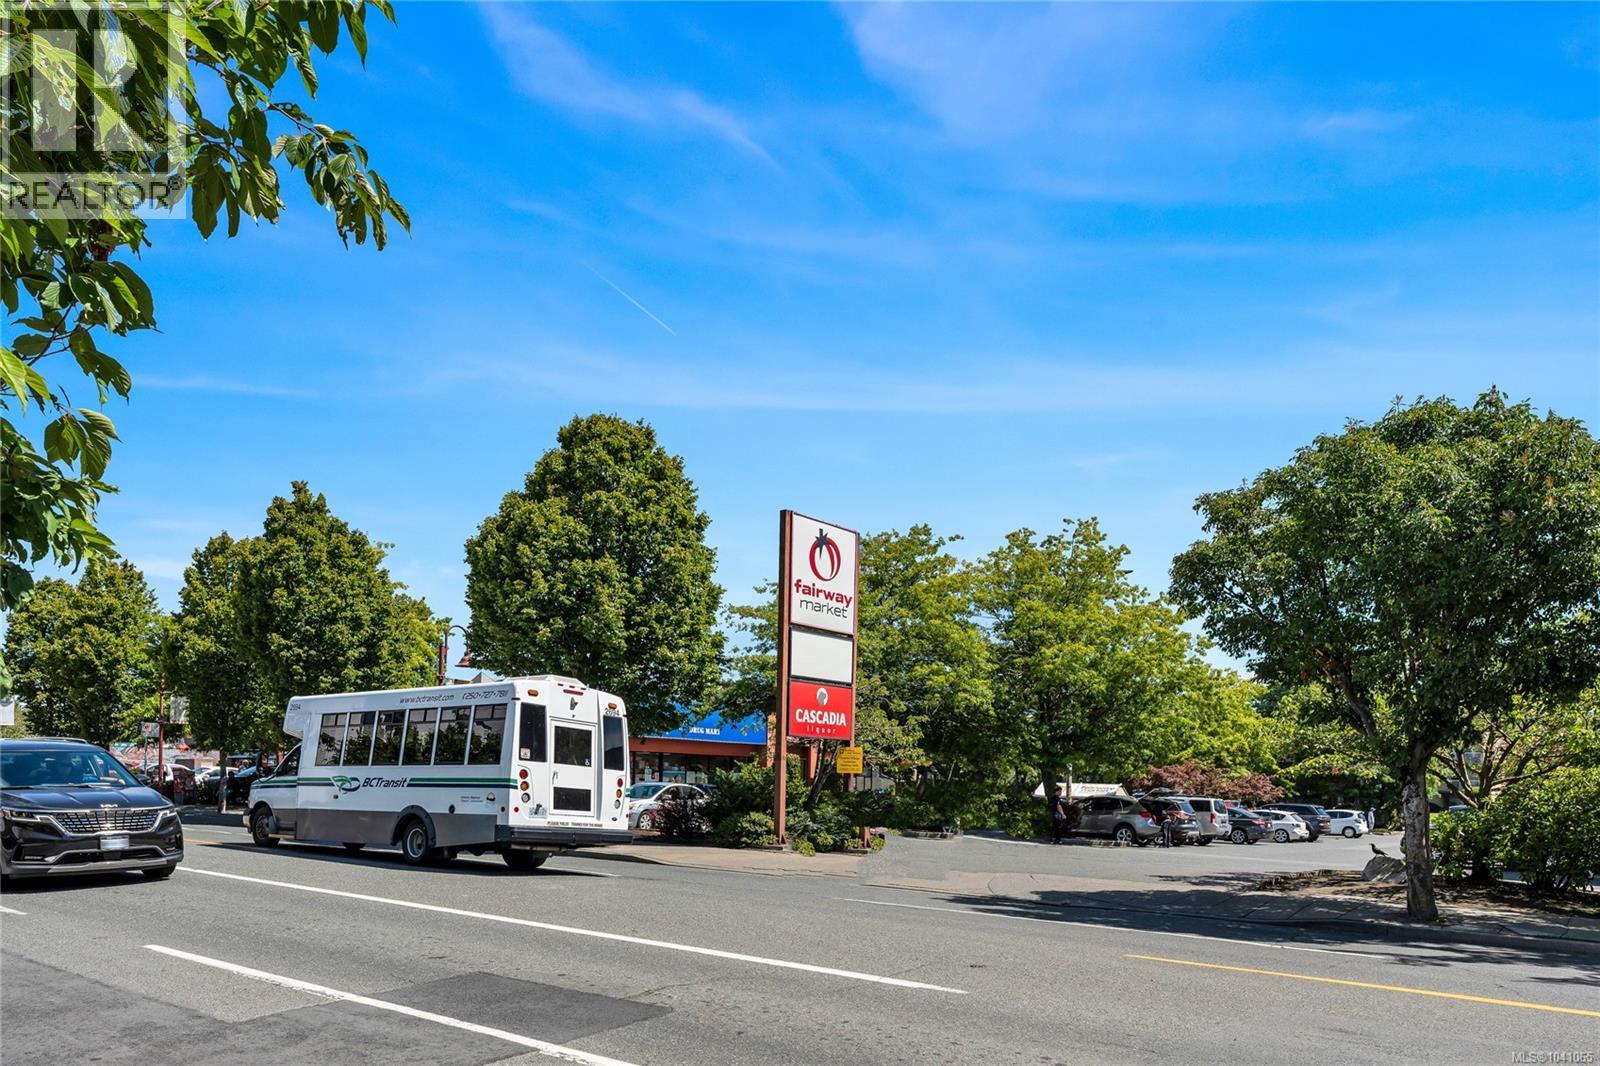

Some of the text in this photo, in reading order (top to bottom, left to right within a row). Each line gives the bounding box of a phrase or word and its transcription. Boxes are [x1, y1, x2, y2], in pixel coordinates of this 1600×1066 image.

[794, 579, 852, 608] fairway
[800, 599, 847, 618] market
[400, 694, 454, 704] www.bctransit.com
[795, 708, 846, 726] CASCADIA
[806, 724, 837, 735] liquor
[362, 777, 407, 788] BCTransit
